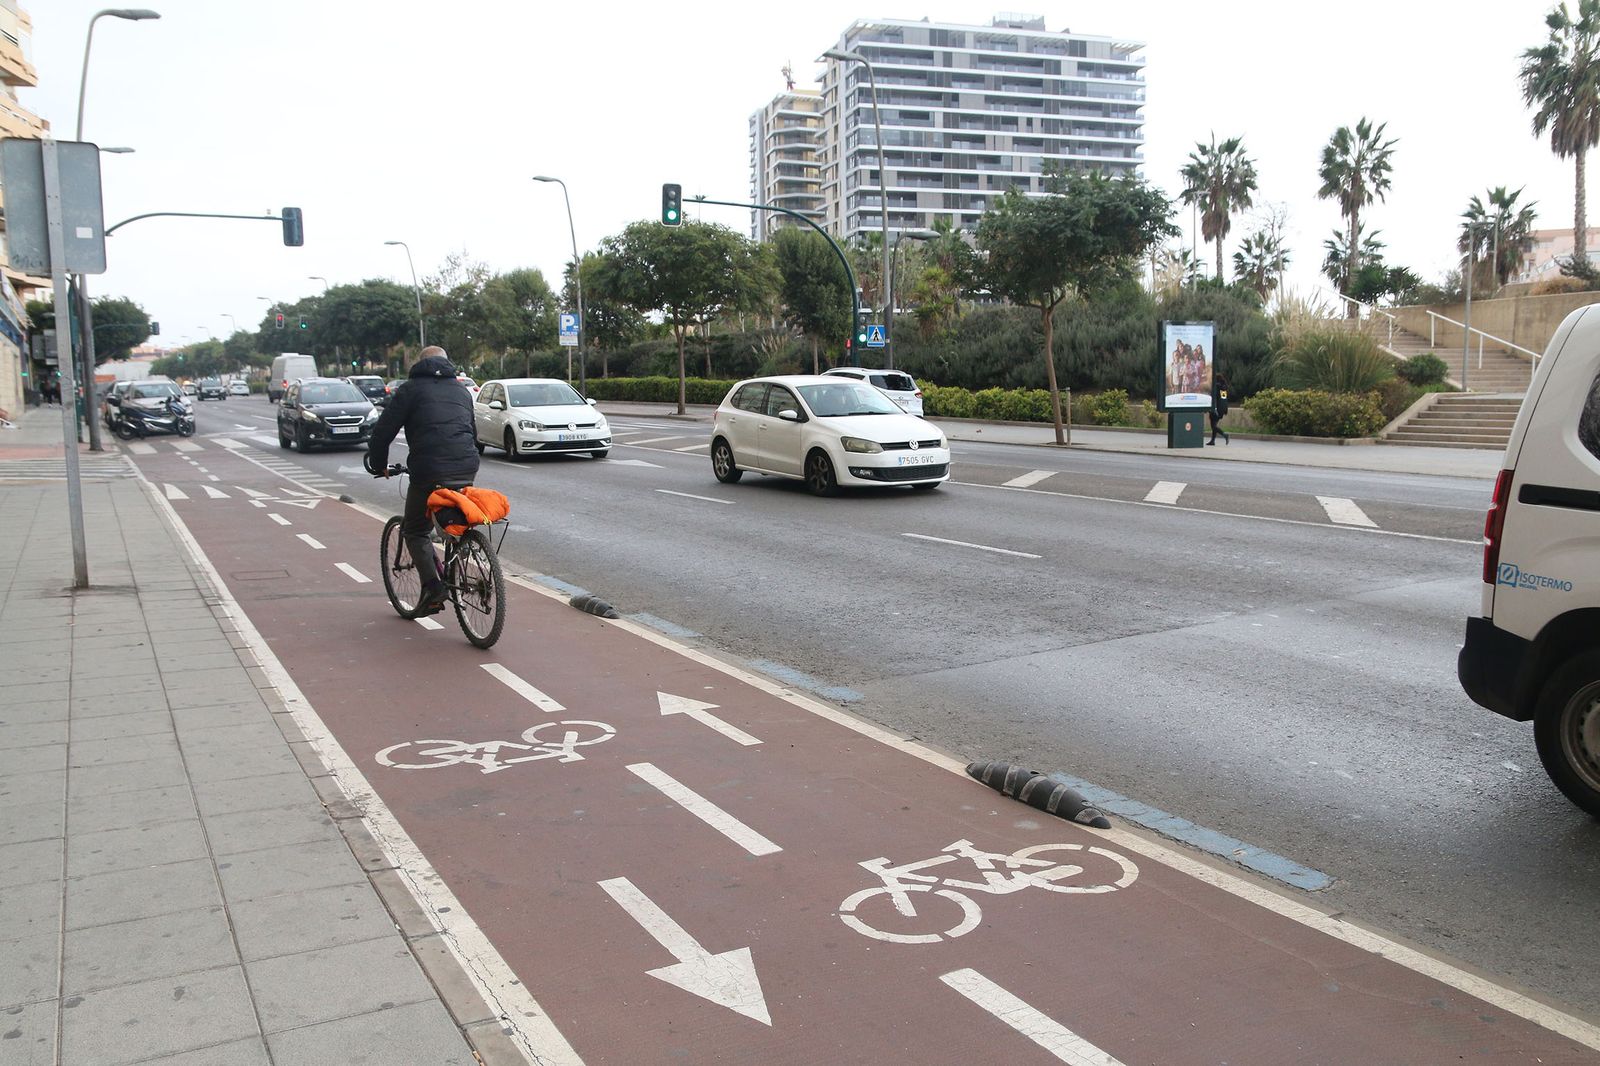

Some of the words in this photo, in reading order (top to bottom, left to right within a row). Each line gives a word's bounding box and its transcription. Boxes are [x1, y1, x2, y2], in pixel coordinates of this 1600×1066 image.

[561, 314, 575, 331] P
[902, 456, 919, 465] 7505
[921, 455, 935, 464] GVC
[1520, 572, 1573, 592] ISOTERMO
